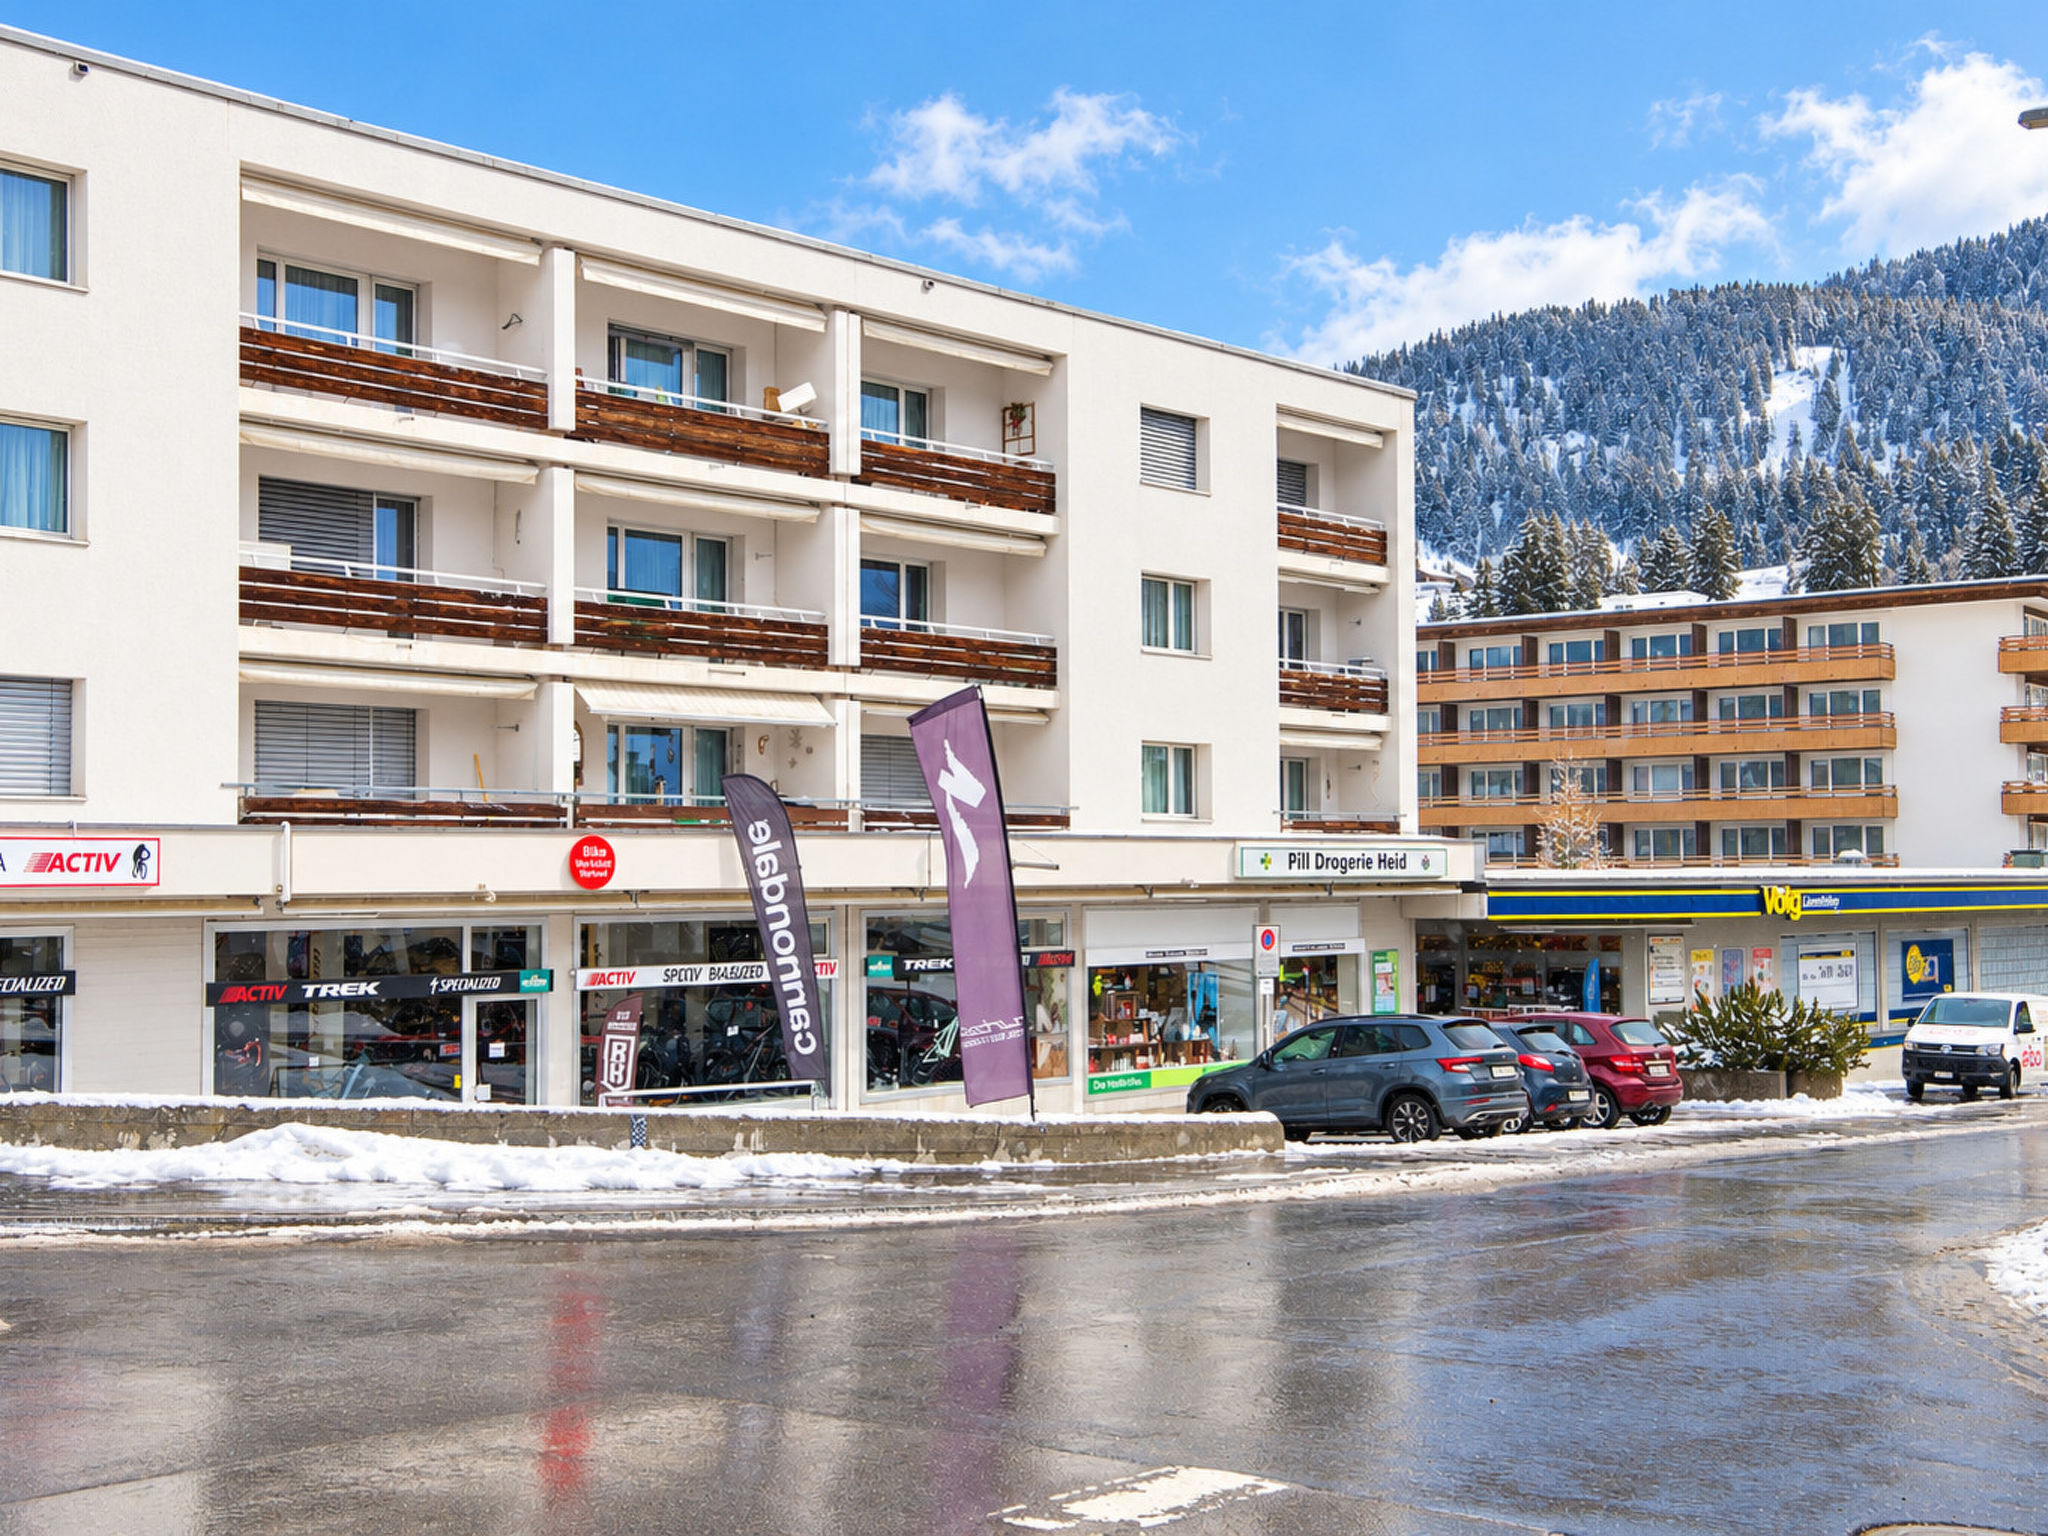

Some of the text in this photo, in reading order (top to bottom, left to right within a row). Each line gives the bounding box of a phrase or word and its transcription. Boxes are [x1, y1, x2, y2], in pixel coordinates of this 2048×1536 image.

[47, 852, 121, 873] ACTIV
[1288, 852, 1407, 874] Pill Drogerie Heid
[903, 958, 954, 971] TREK
[0, 976, 67, 992] CIALIZED
[598, 971, 636, 986] ACTIV
[236, 985, 288, 1002] ACTIV
[301, 981, 381, 998] TREK
